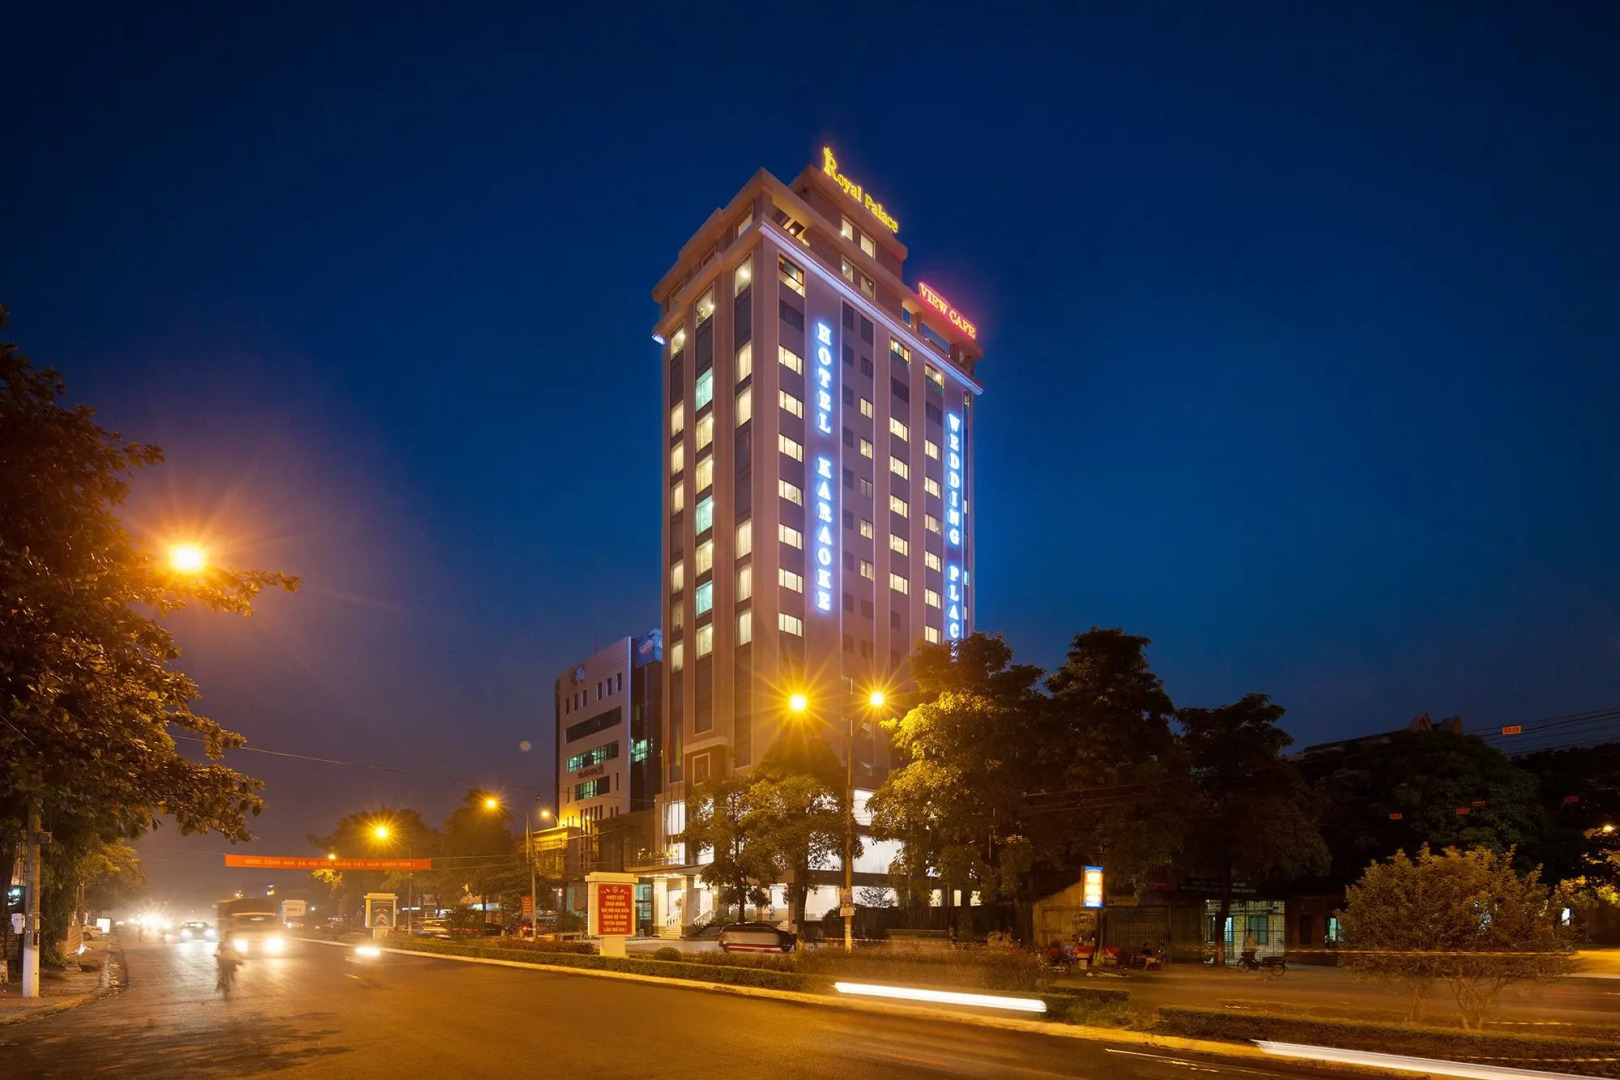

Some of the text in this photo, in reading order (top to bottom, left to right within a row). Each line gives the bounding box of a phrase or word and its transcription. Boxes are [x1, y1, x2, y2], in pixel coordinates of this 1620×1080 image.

[823, 146, 899, 234] Royal Palace
[918, 281, 977, 340] VIEW CAFE
[816, 321, 833, 612] HOTEL KARAOKE
[947, 412, 961, 546] WEDDING
